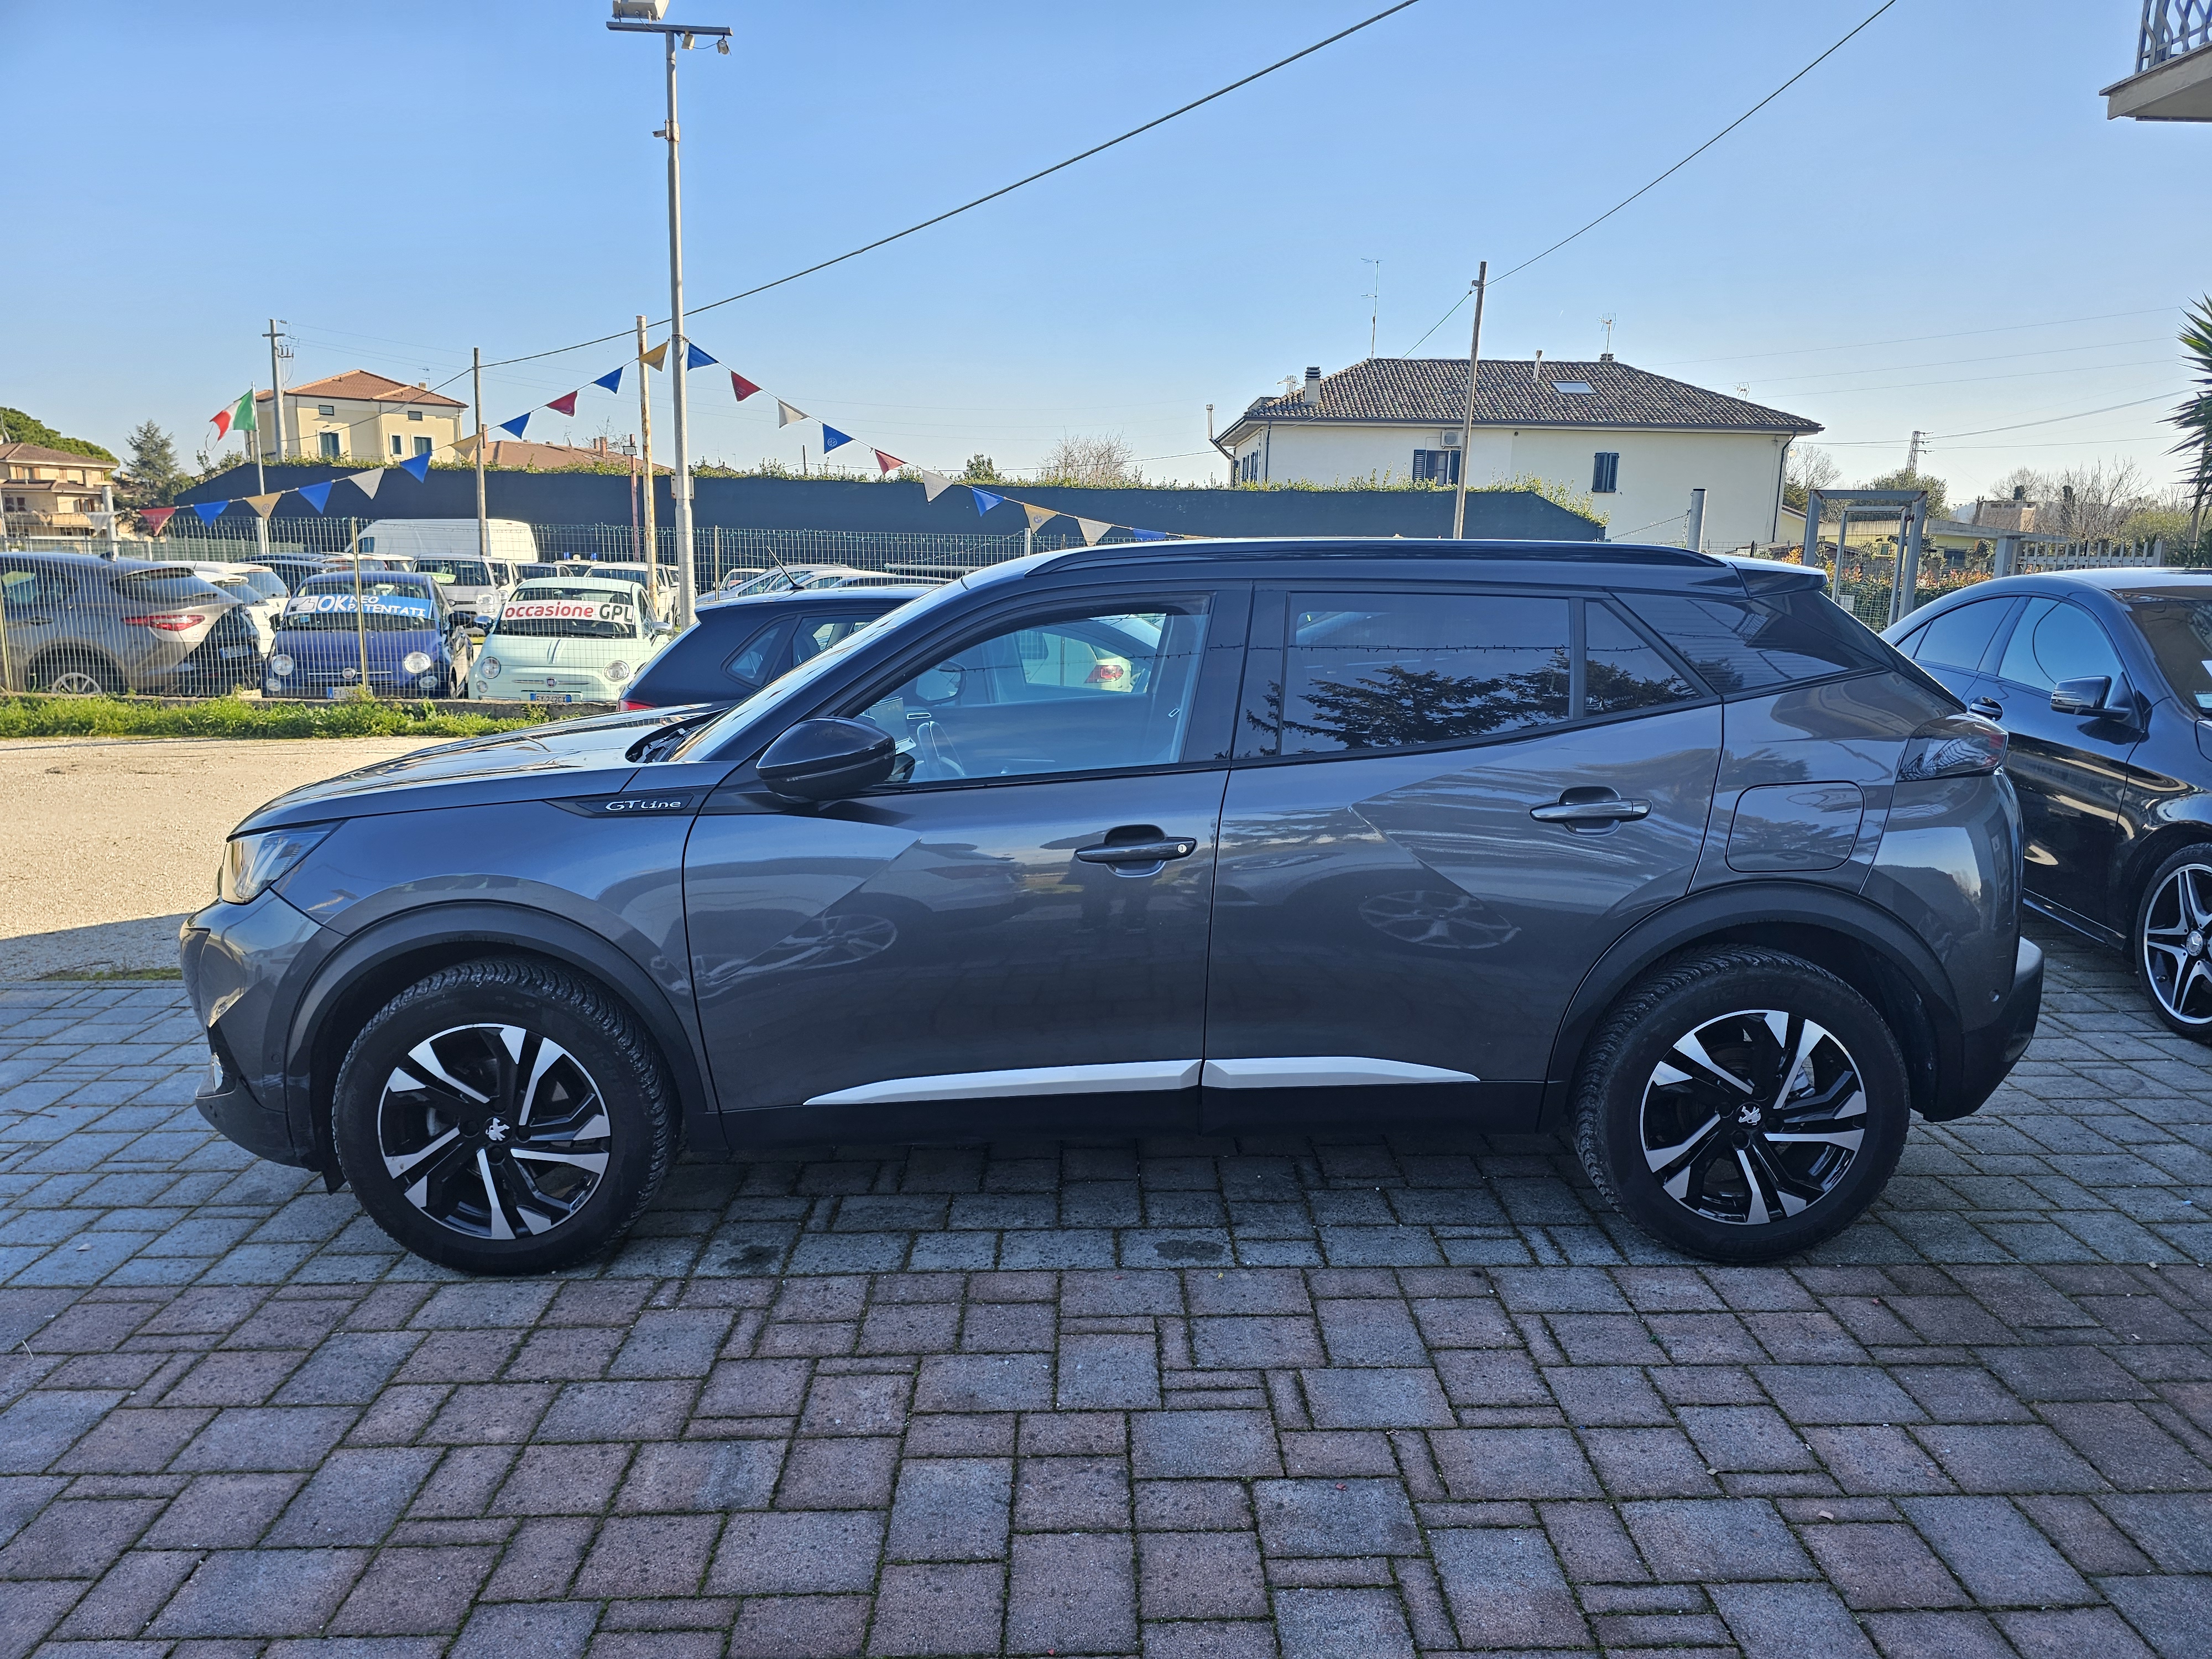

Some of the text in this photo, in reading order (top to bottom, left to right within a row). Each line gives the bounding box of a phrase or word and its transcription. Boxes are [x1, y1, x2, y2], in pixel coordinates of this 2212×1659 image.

[317, 595, 349, 612] OK
[349, 595, 379, 604] NEO
[505, 602, 633, 622] occasione GPL
